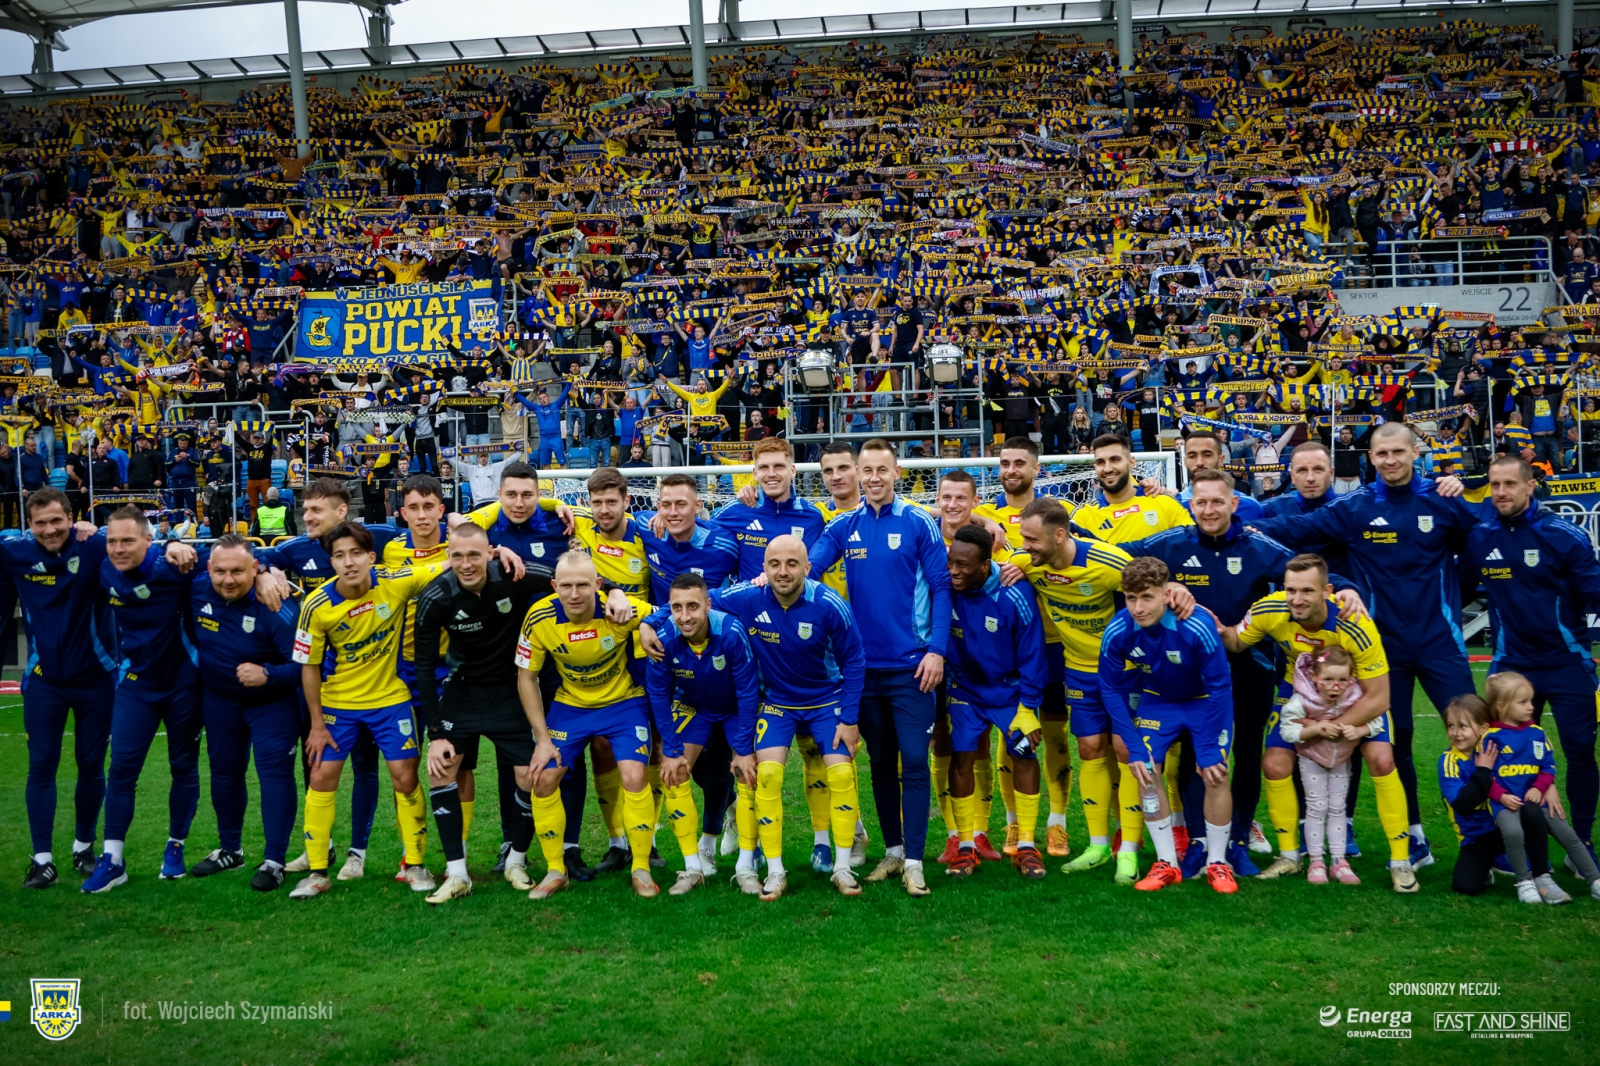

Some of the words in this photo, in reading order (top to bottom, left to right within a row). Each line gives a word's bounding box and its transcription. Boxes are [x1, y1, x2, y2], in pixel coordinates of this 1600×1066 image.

[335, 289, 349, 301] W
[356, 282, 434, 300] JEDNOŚCI
[439, 279, 475, 294] SIŁA
[1350, 292, 1378, 300] SEKTOR
[1460, 287, 1493, 296] WEJŚCIE
[1498, 286, 1533, 312] 22
[345, 295, 462, 321] POWIAT
[343, 315, 463, 356] PUCKI
[315, 356, 368, 366] TYLKO
[374, 353, 422, 364] ARKA
[745, 534, 768, 543] Energa
[1372, 531, 1397, 540] Energa
[598, 545, 623, 557] Betclic
[1185, 574, 1209, 582] Energa
[458, 621, 482, 631] Energa
[1065, 616, 1104, 628] Energa
[570, 629, 596, 641] Betclic
